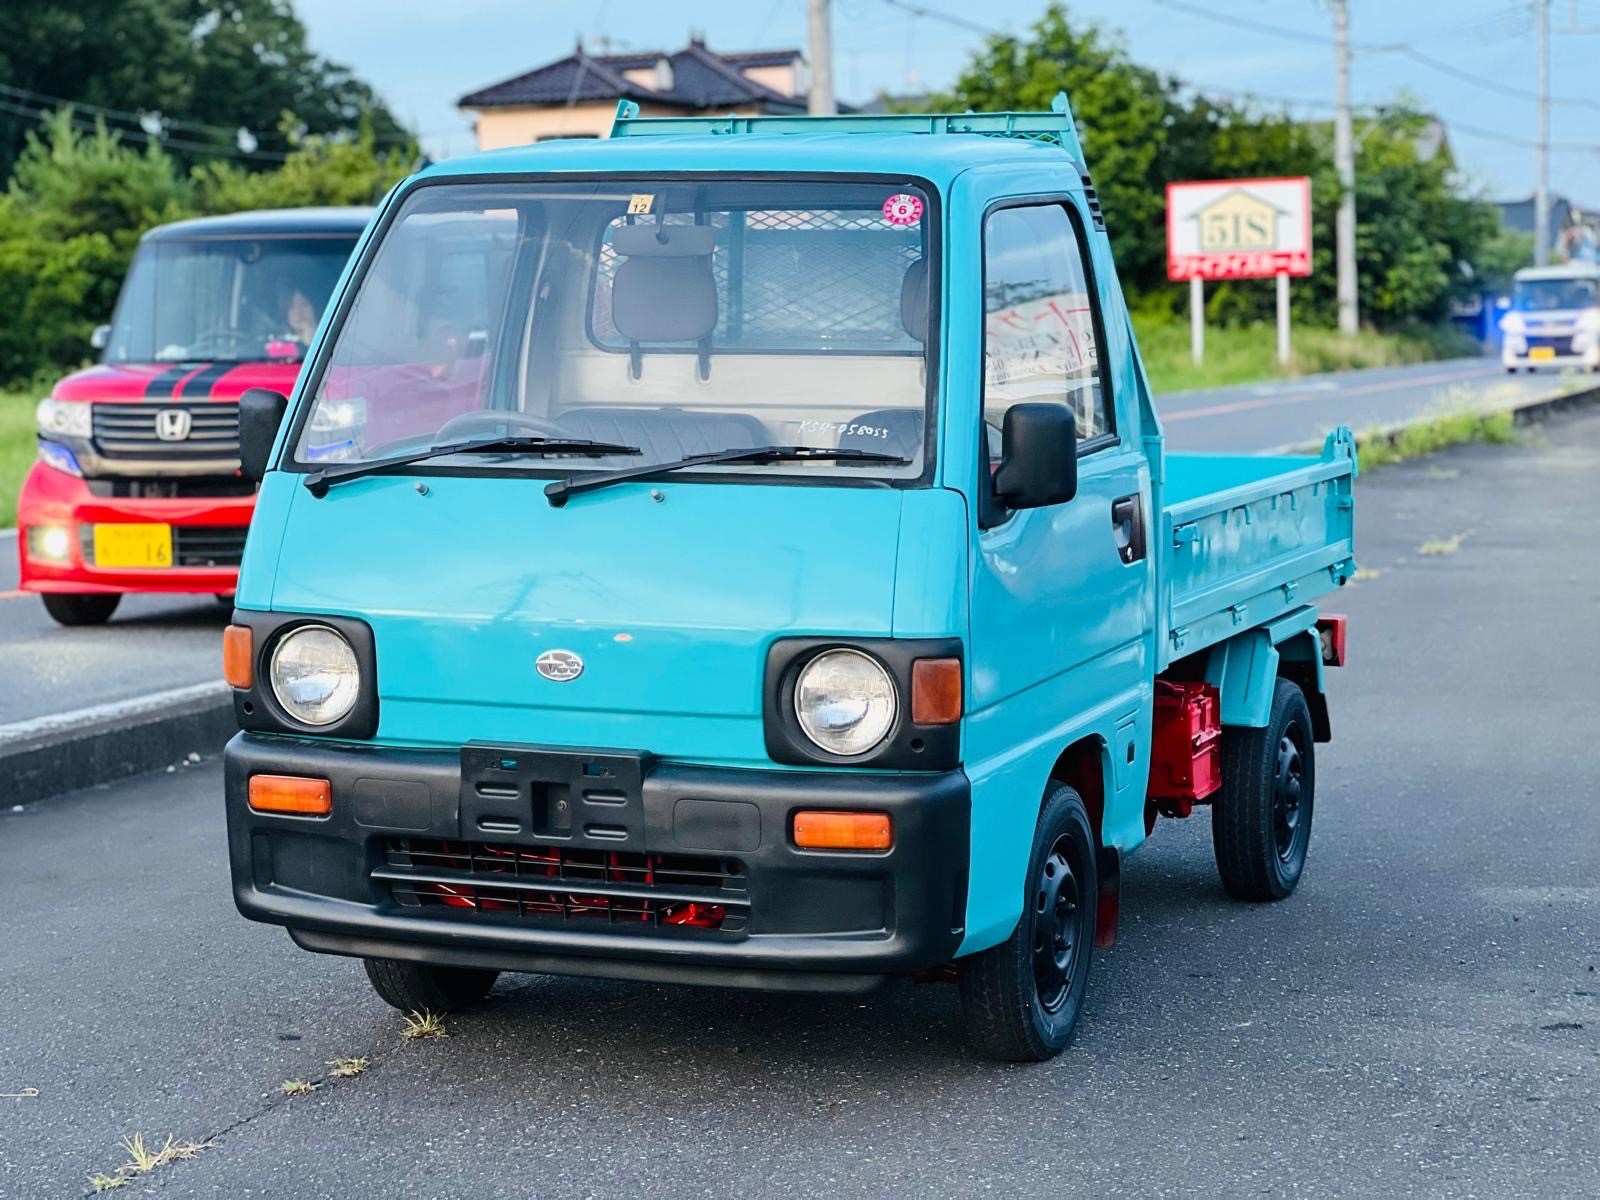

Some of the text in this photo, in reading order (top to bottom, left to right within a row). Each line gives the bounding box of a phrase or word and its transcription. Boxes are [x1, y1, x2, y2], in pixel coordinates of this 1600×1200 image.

[633, 203, 648, 213] 12
[898, 205, 908, 215] 6
[146, 541, 167, 563] 16
